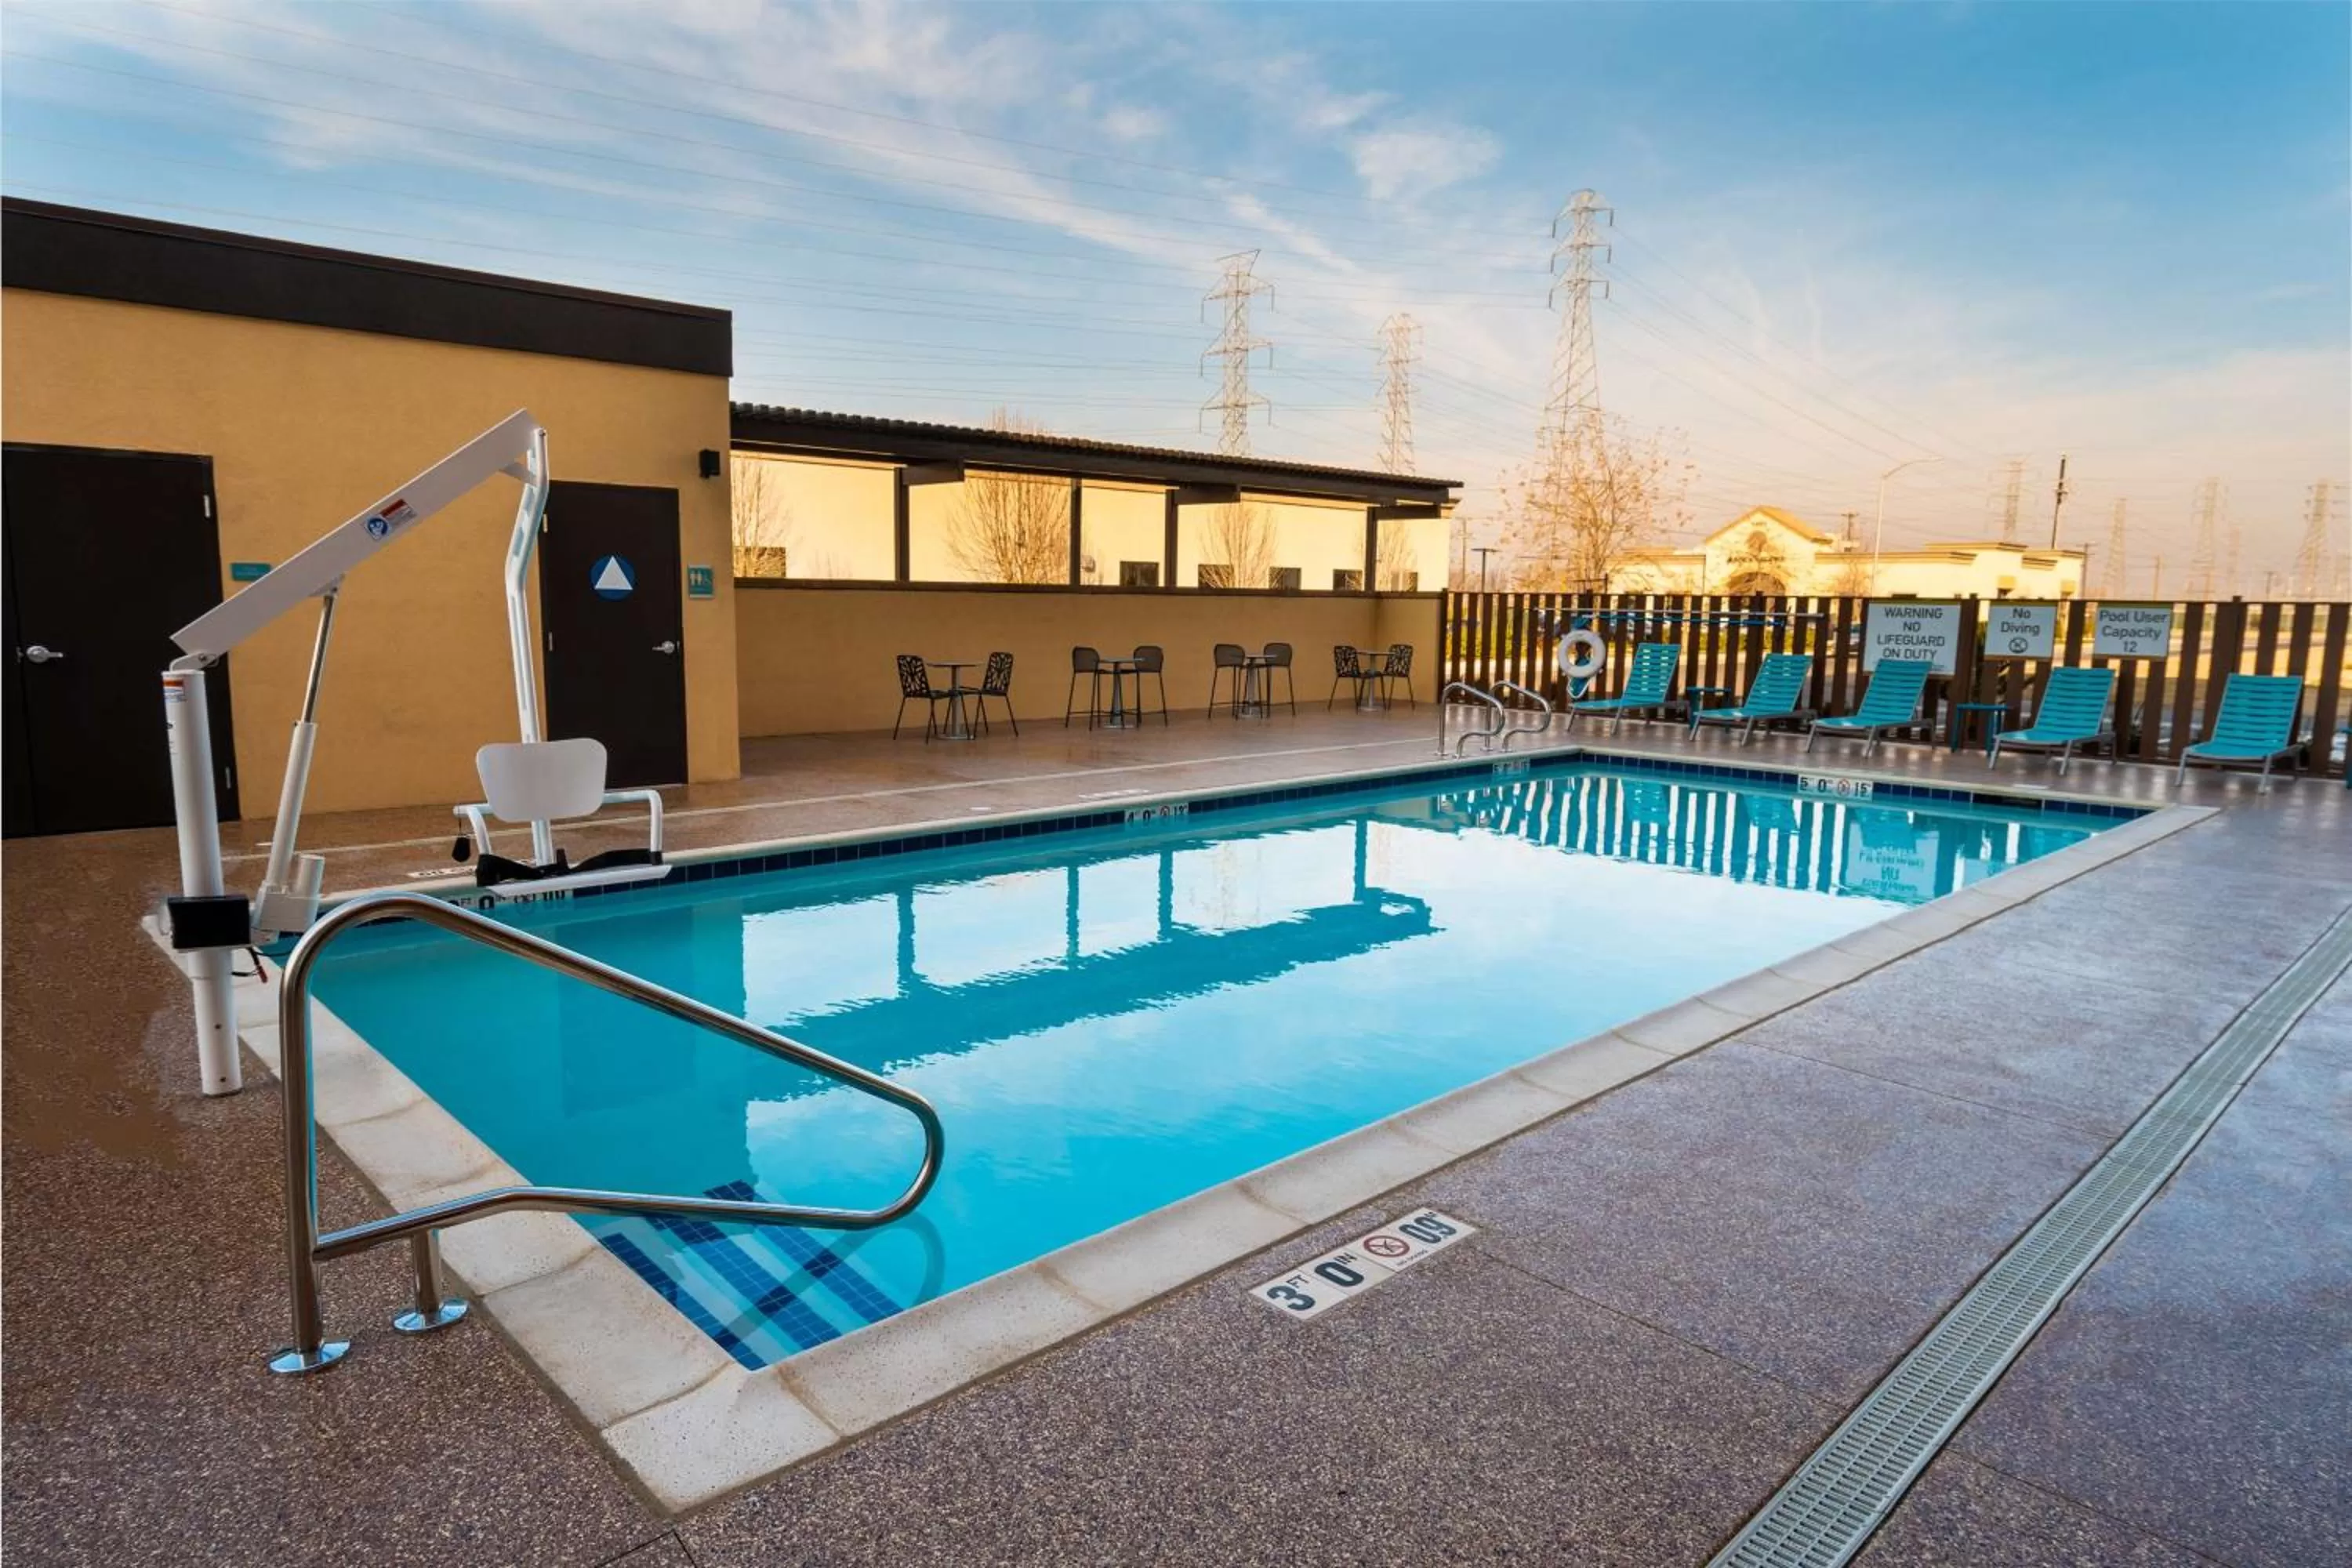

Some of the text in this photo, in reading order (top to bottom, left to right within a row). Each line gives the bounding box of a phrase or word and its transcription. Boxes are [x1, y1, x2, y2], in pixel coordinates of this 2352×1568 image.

[1884, 607, 1944, 619] WARNING
[2013, 608, 2032, 619] No
[2100, 610, 2168, 623] Pool User
[1903, 621, 1922, 632] NO
[2000, 621, 2041, 637] Diving
[2102, 625, 2162, 641] Capacity
[1877, 633, 1945, 647] LIFEGUARD
[2123, 641, 2138, 653] 12
[1882, 648, 1936, 659] ON DUTY
